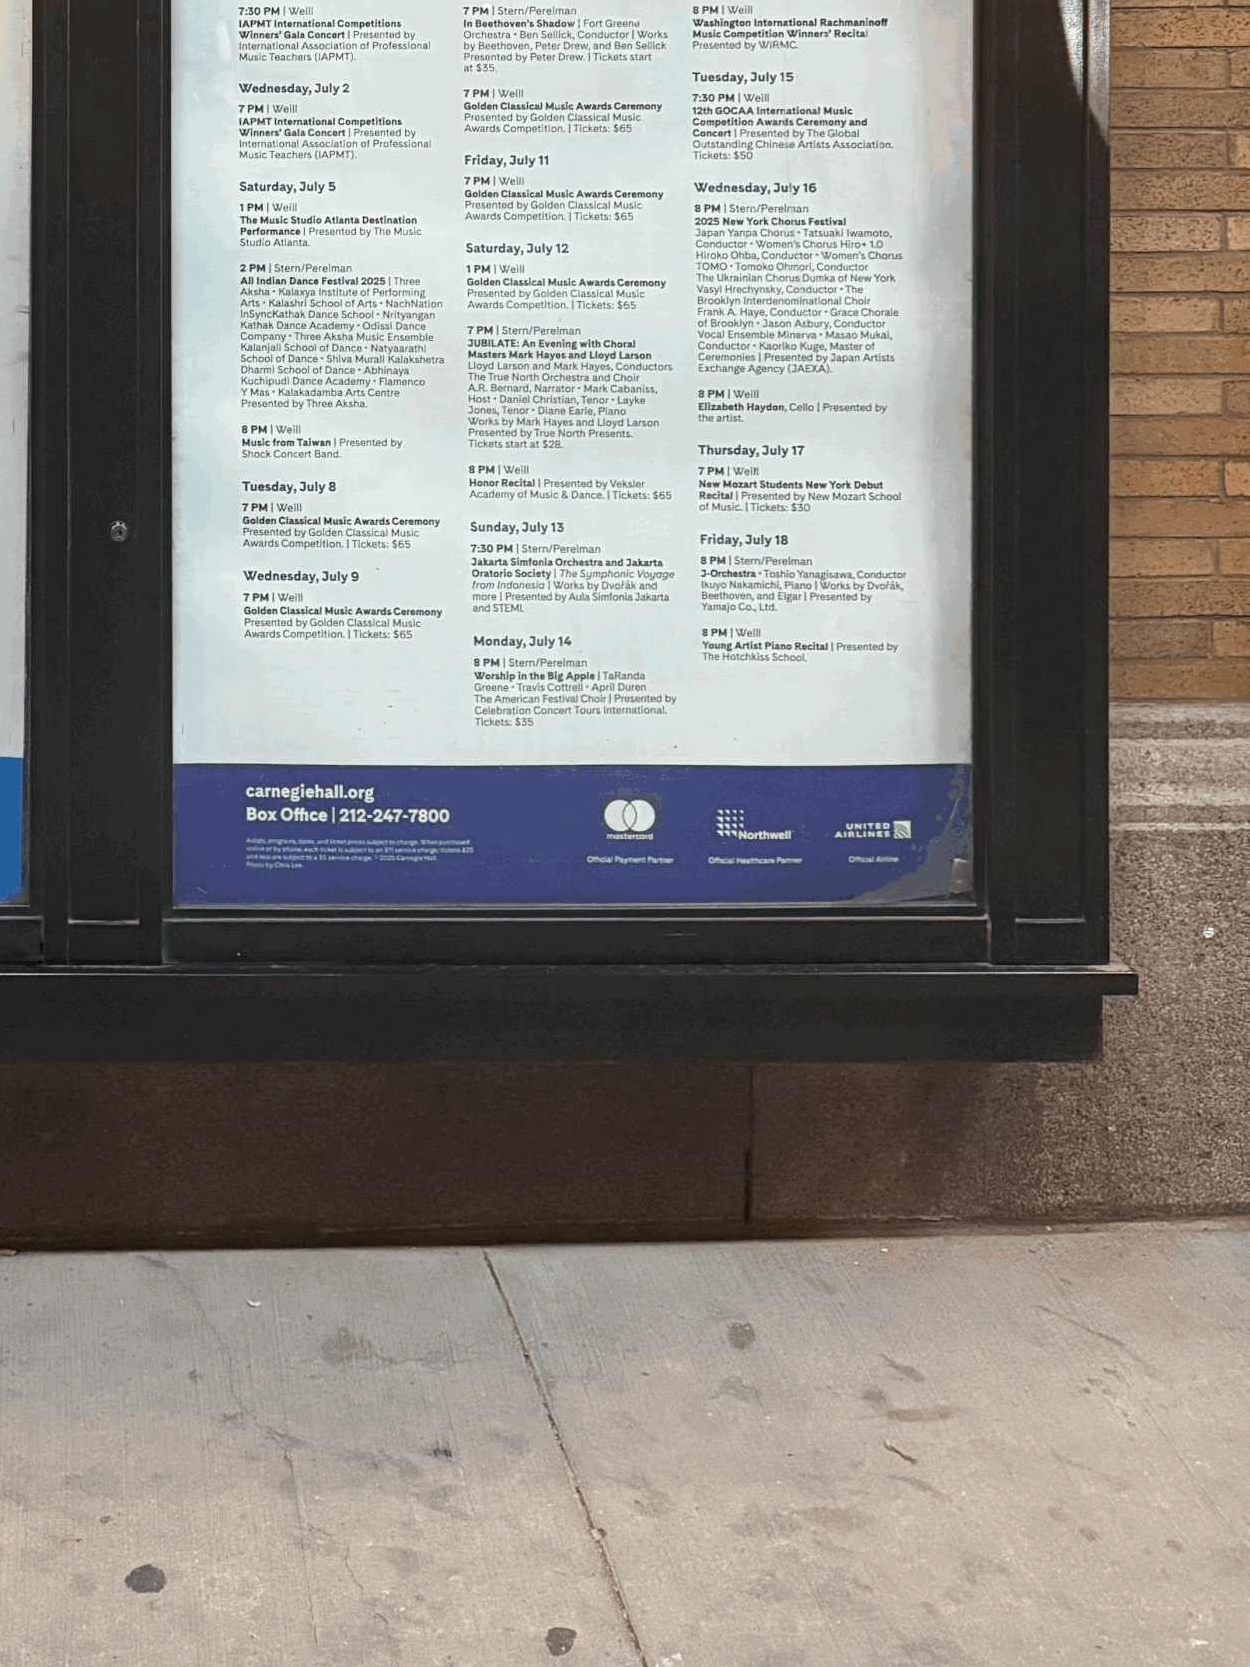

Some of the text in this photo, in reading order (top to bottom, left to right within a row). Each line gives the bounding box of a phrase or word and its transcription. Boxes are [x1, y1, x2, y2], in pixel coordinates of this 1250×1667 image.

[692, 17, 889, 30] Washington International Rachmaninoff
[691, 71, 794, 85] Tuesday, July 15
[238, 82, 350, 96] Wednesday, July 2
[464, 153, 549, 169] Friday, July 11
[239, 180, 337, 195] Saturday, July 5
[693, 181, 817, 196] Wednesday, July 16
[465, 242, 570, 257] Saturday, July 12
[697, 444, 806, 459] Thursday, July 17
[241, 480, 337, 495] Tuesday, July 8
[469, 520, 565, 536] Sunday, July 13
[699, 532, 789, 548] Friday, July 18
[242, 569, 360, 585] Wednesday, July 9
[473, 635, 573, 650] Monday, July 14
[245, 783, 375, 804] carnegiehall.org
[246, 806, 451, 824] Box Office 212-247-7800
[845, 820, 891, 831] UNITED
[606, 833, 654, 841] mastercard
[738, 829, 792, 840] Northwell
[833, 829, 891, 839] AIRLINES
